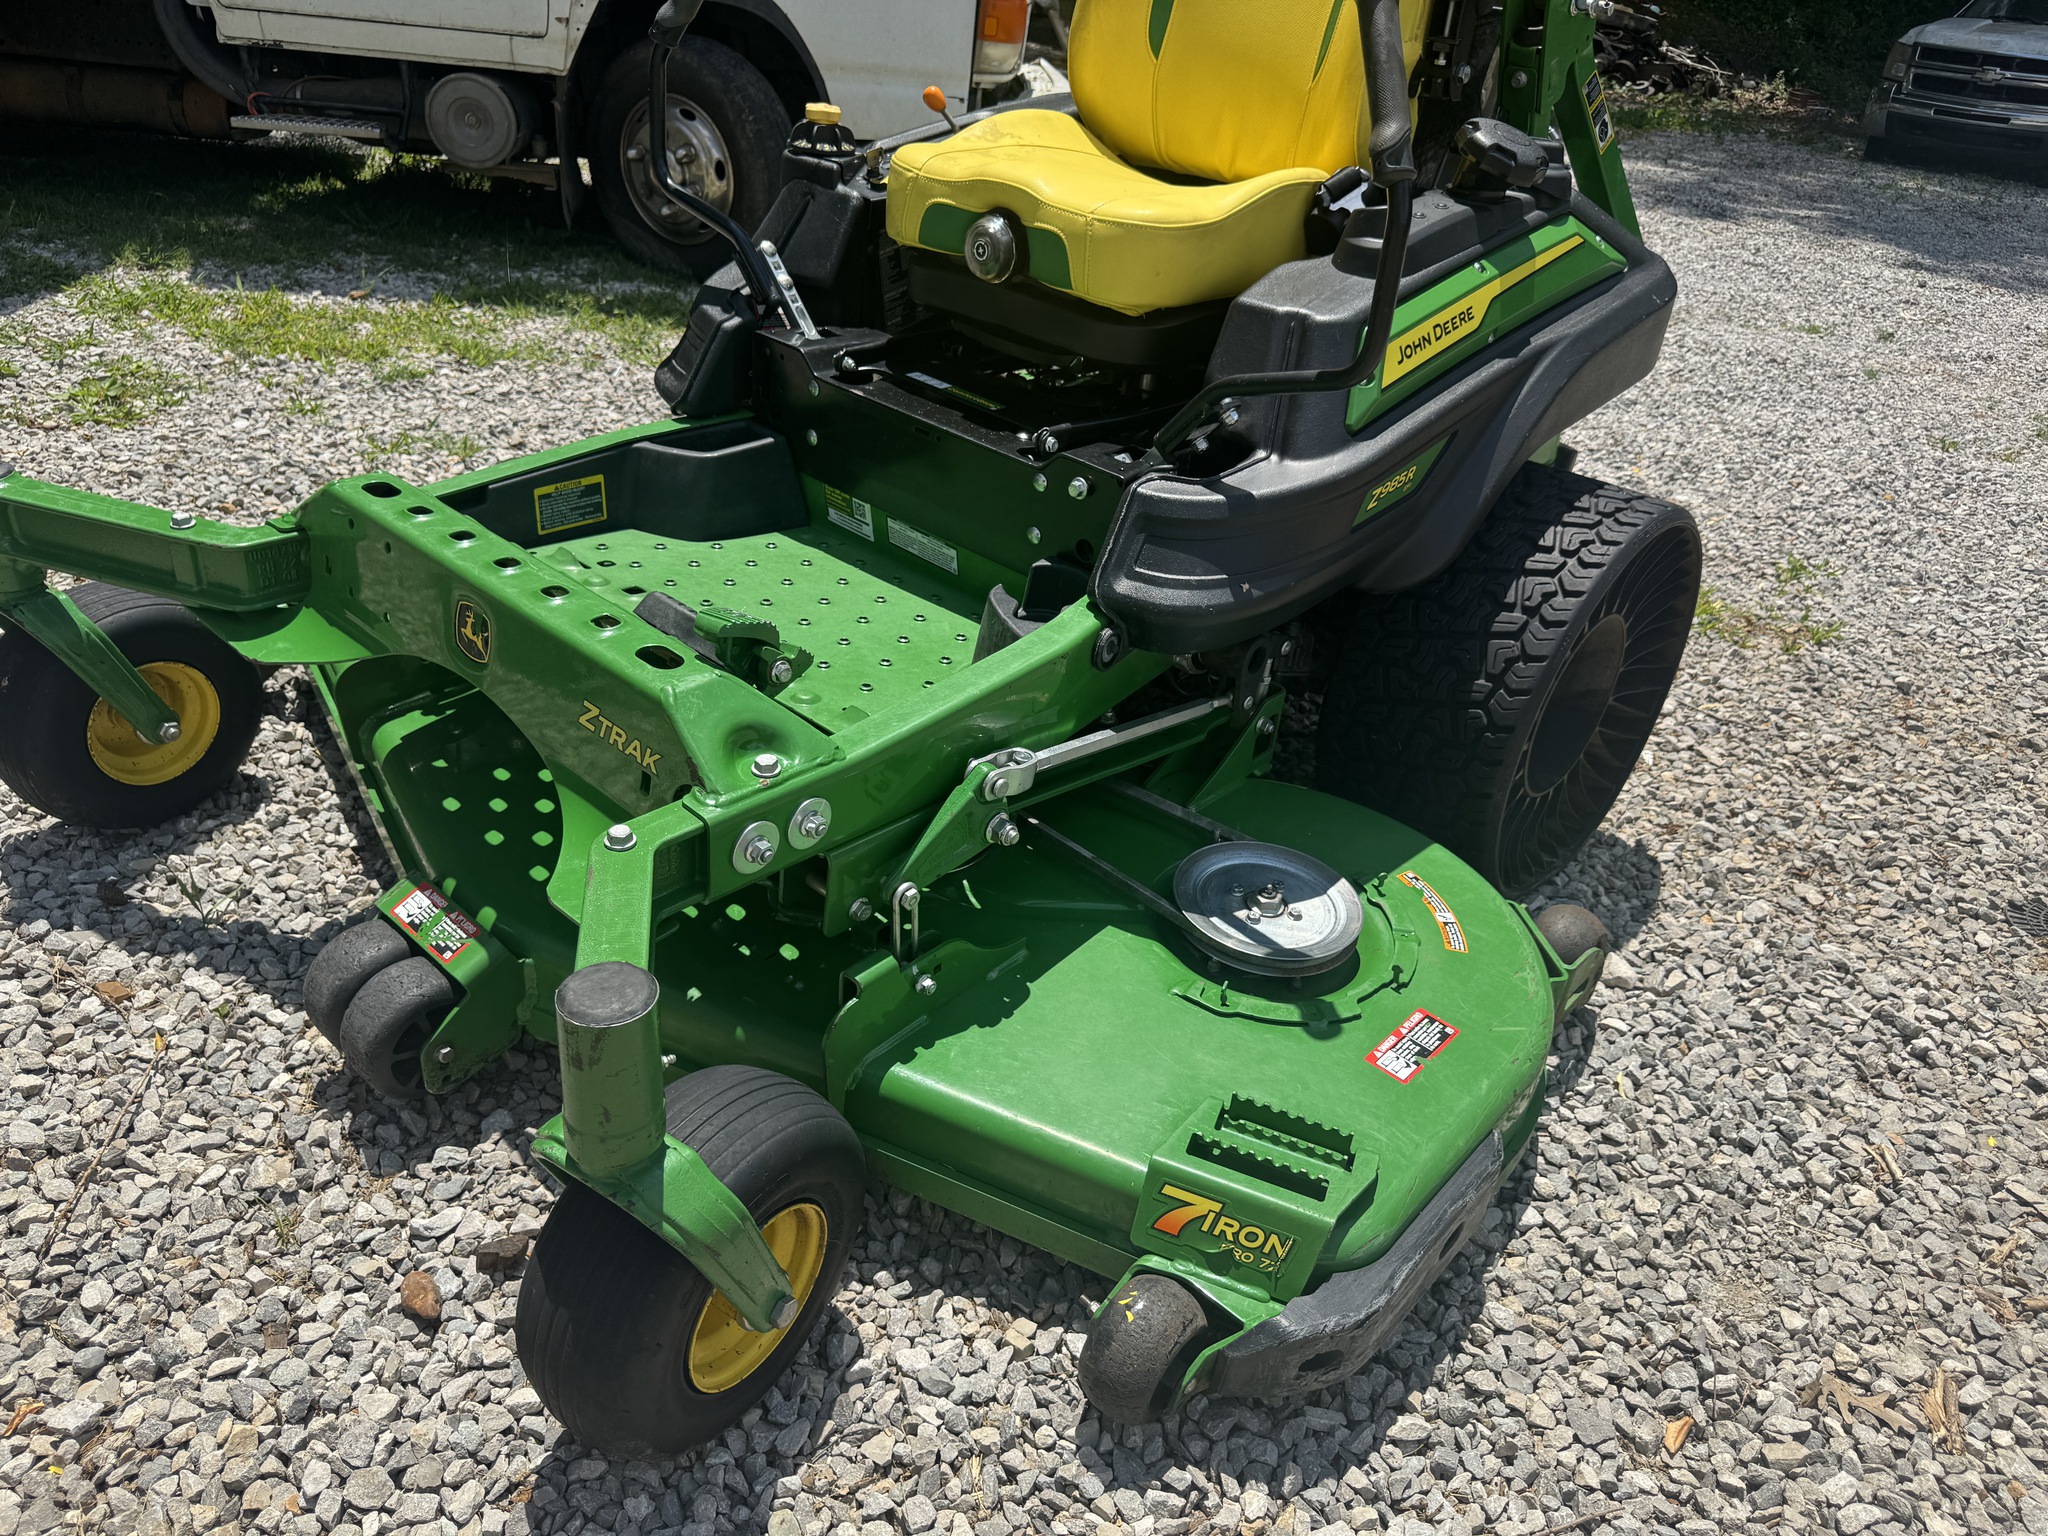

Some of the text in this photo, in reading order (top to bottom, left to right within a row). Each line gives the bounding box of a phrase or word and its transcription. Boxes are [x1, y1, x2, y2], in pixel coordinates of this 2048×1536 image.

[1397, 305, 1475, 366] JOHN DEERE
[559, 480, 582, 490] CAUTION
[1366, 465, 1417, 511] Z985R
[578, 699, 662, 776] ZTRAK
